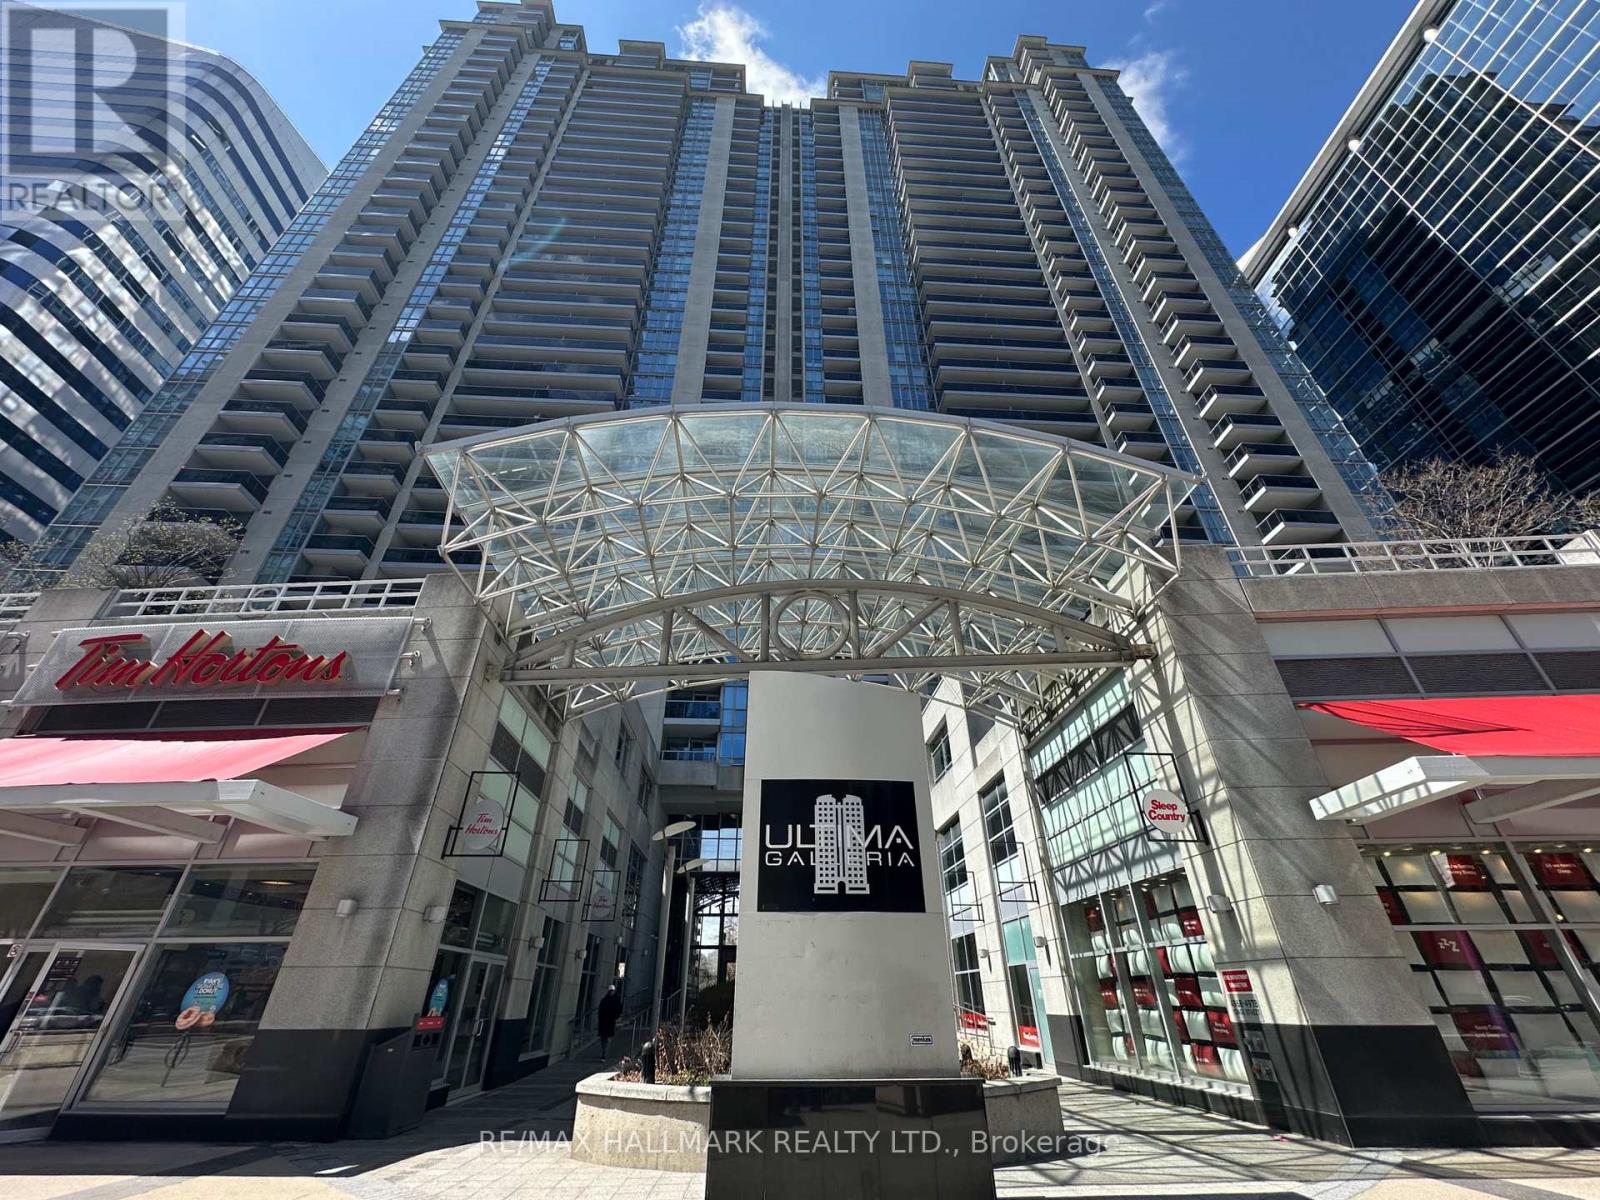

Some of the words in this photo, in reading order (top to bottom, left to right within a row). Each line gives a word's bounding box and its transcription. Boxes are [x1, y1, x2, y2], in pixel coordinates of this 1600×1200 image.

[55, 633, 153, 690] Tim
[149, 628, 347, 687] Hortons
[1151, 799, 1178, 811] Sleep
[476, 812, 493, 823] Tim
[1148, 809, 1186, 822] Country
[465, 824, 498, 835] Hortons
